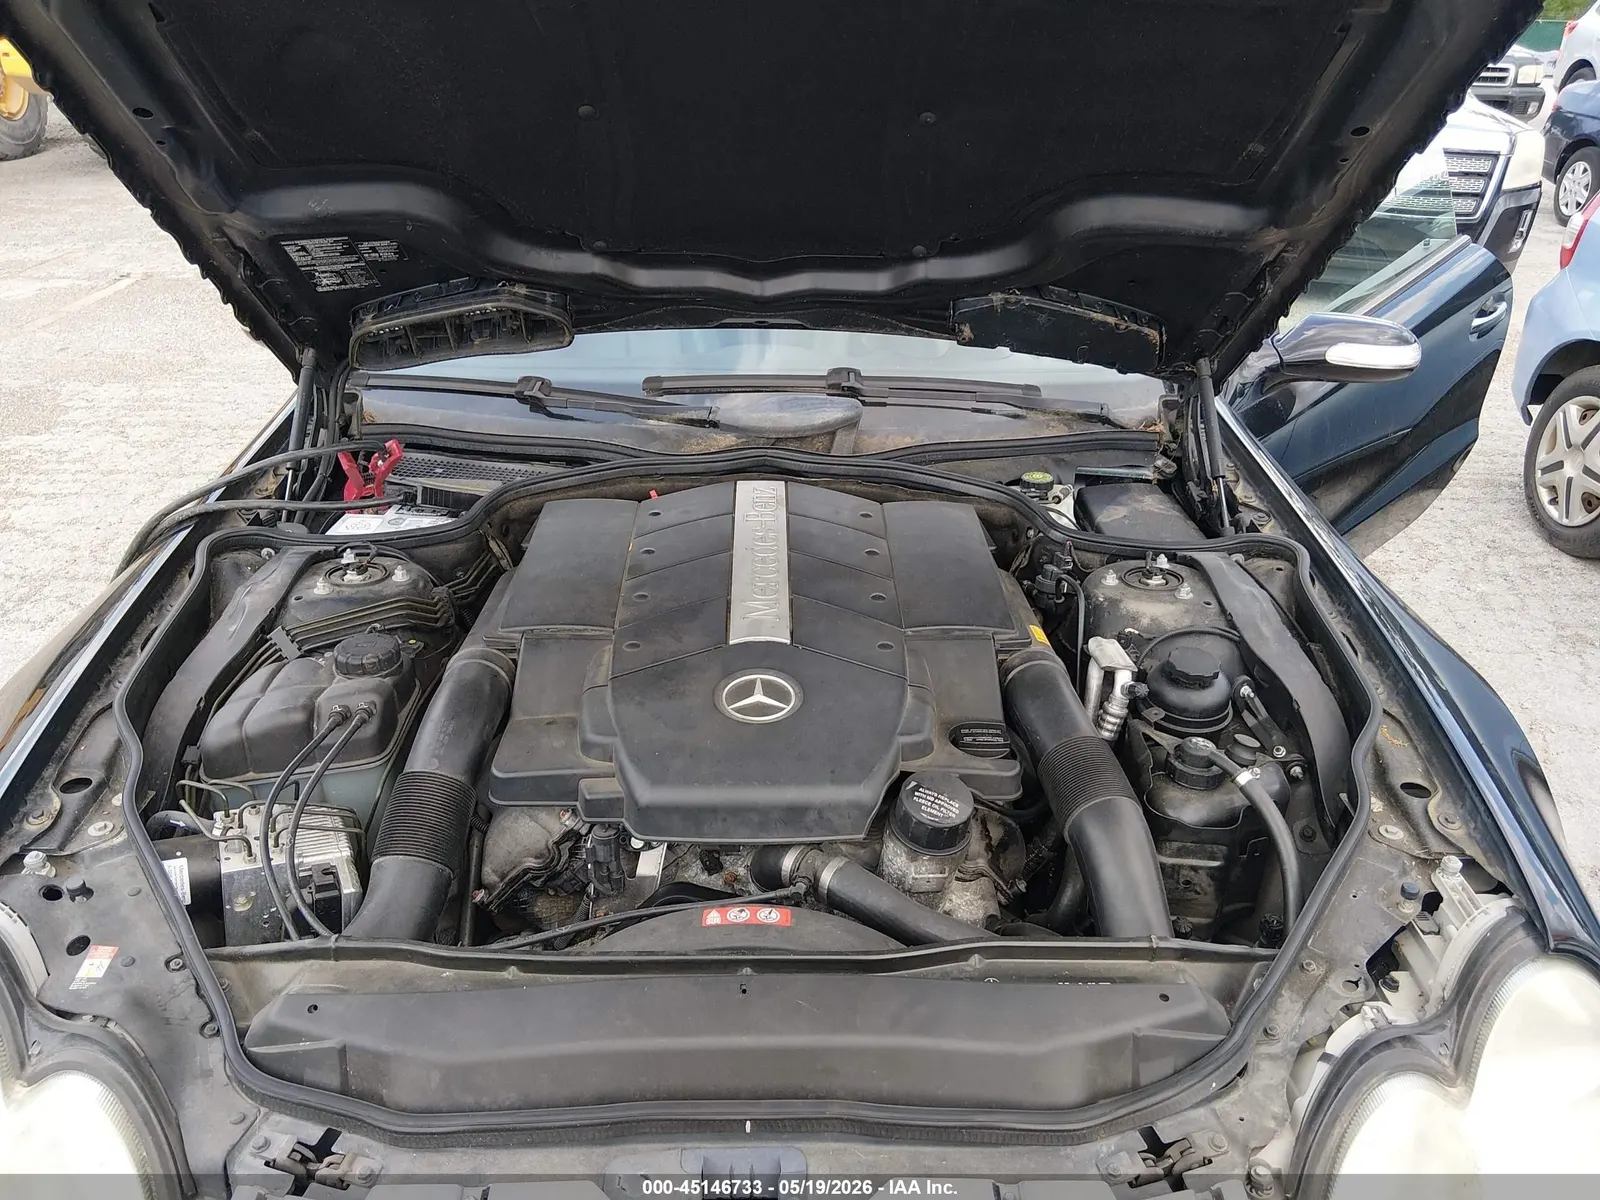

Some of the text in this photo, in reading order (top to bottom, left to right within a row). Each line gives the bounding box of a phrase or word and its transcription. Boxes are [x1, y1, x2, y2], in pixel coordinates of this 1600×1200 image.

[742, 486, 779, 622] Mercedes-Benz
[913, 796, 932, 806] FLEECE
[940, 807, 956, 818] FILTER
[914, 791, 926, 799] WITH
[934, 799, 960, 814] APPROVED
[918, 787, 960, 808] ALWAYS REPLACE
[921, 805, 943, 817] ELEMENT
